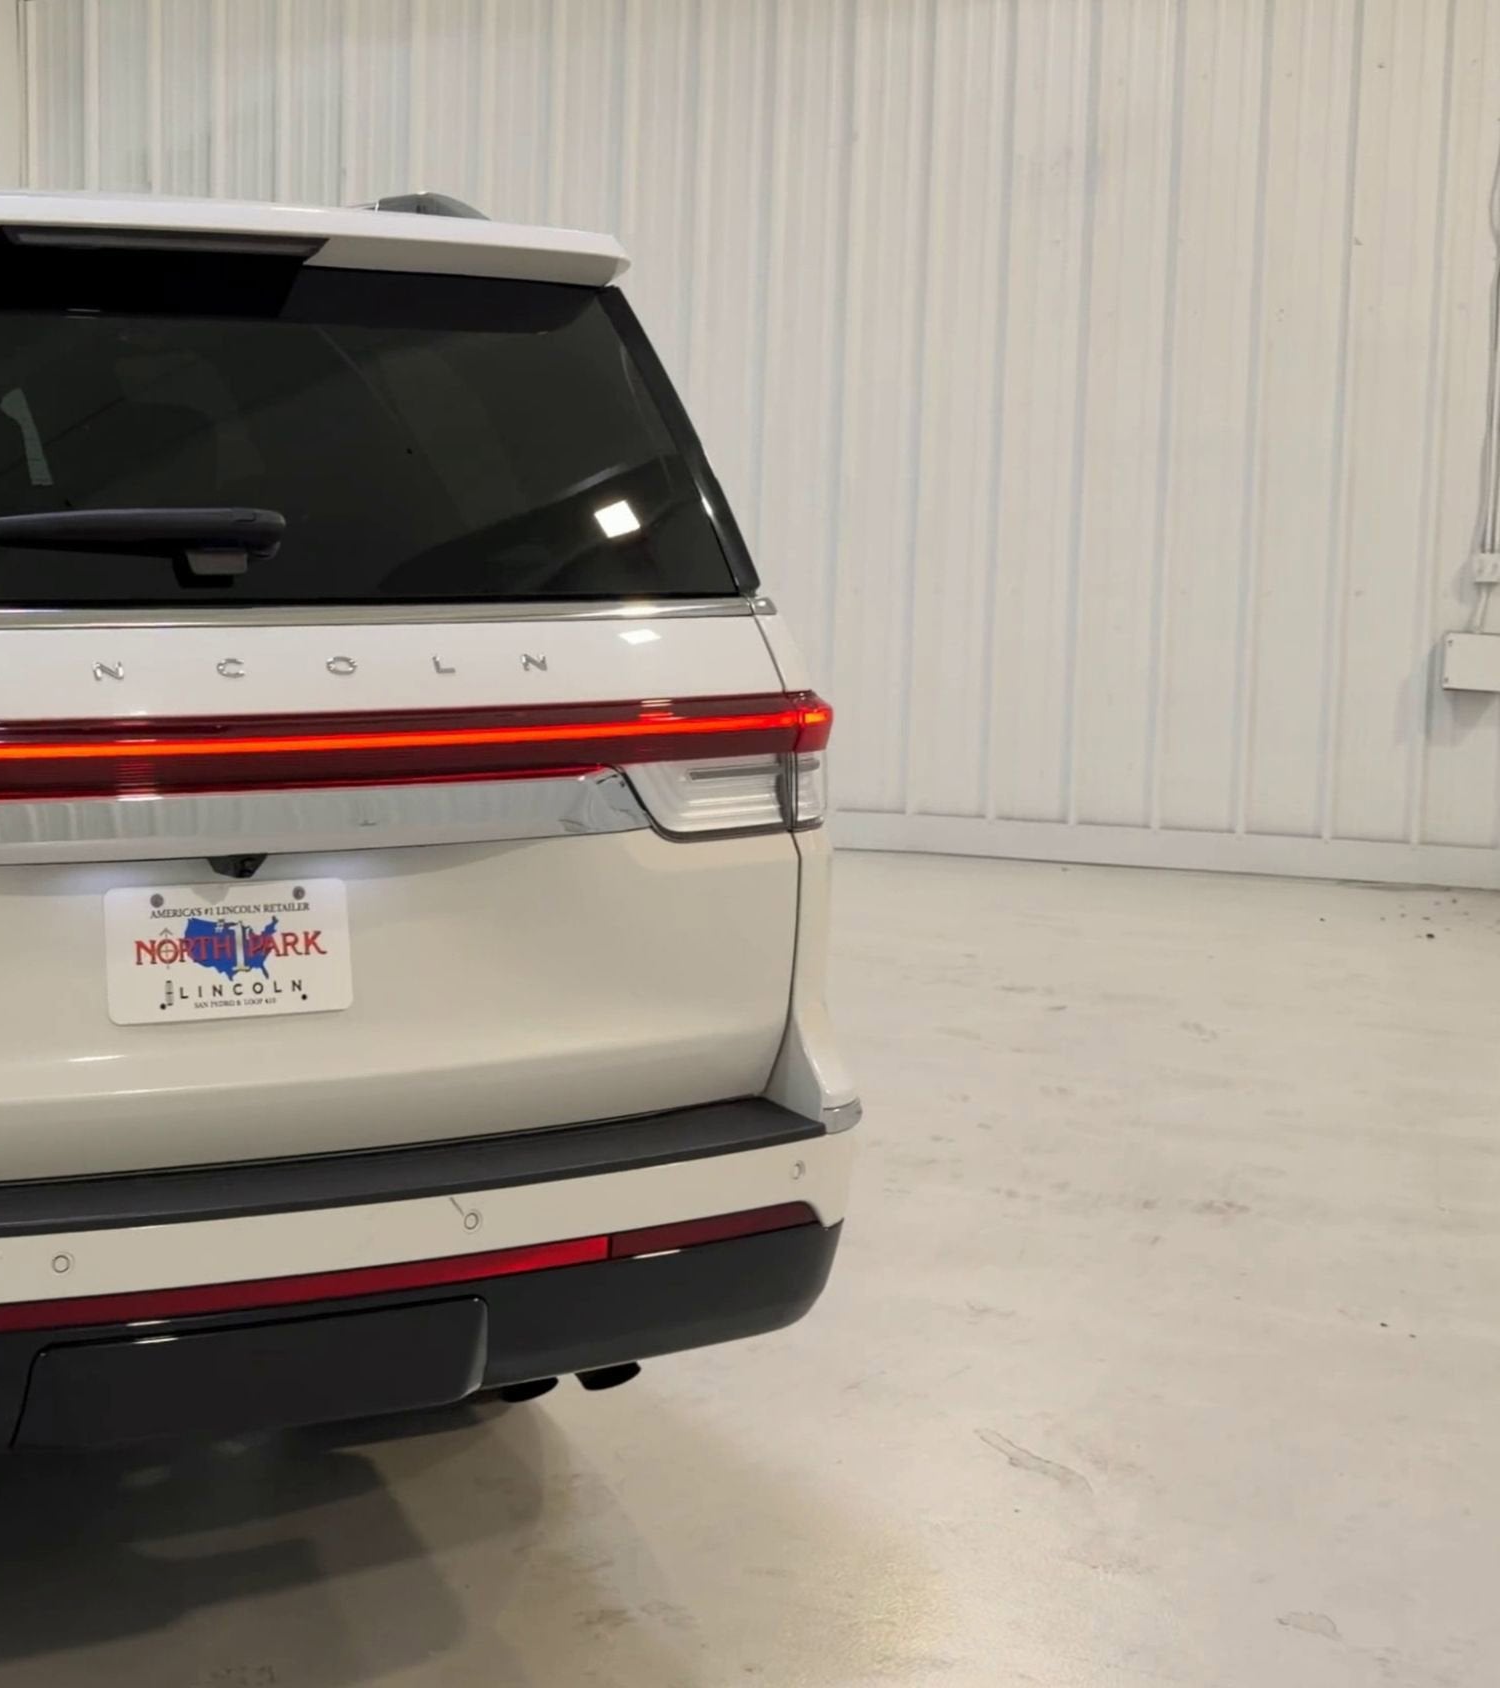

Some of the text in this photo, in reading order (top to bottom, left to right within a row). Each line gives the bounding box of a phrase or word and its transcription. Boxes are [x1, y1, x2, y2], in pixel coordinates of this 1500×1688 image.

[150, 906, 203, 919] AMERICA'S
[216, 903, 262, 916] LINCOLN
[263, 901, 310, 914] RETAILER
[134, 930, 328, 966] NORTH PARK
[179, 979, 303, 1000] LINCOLN
